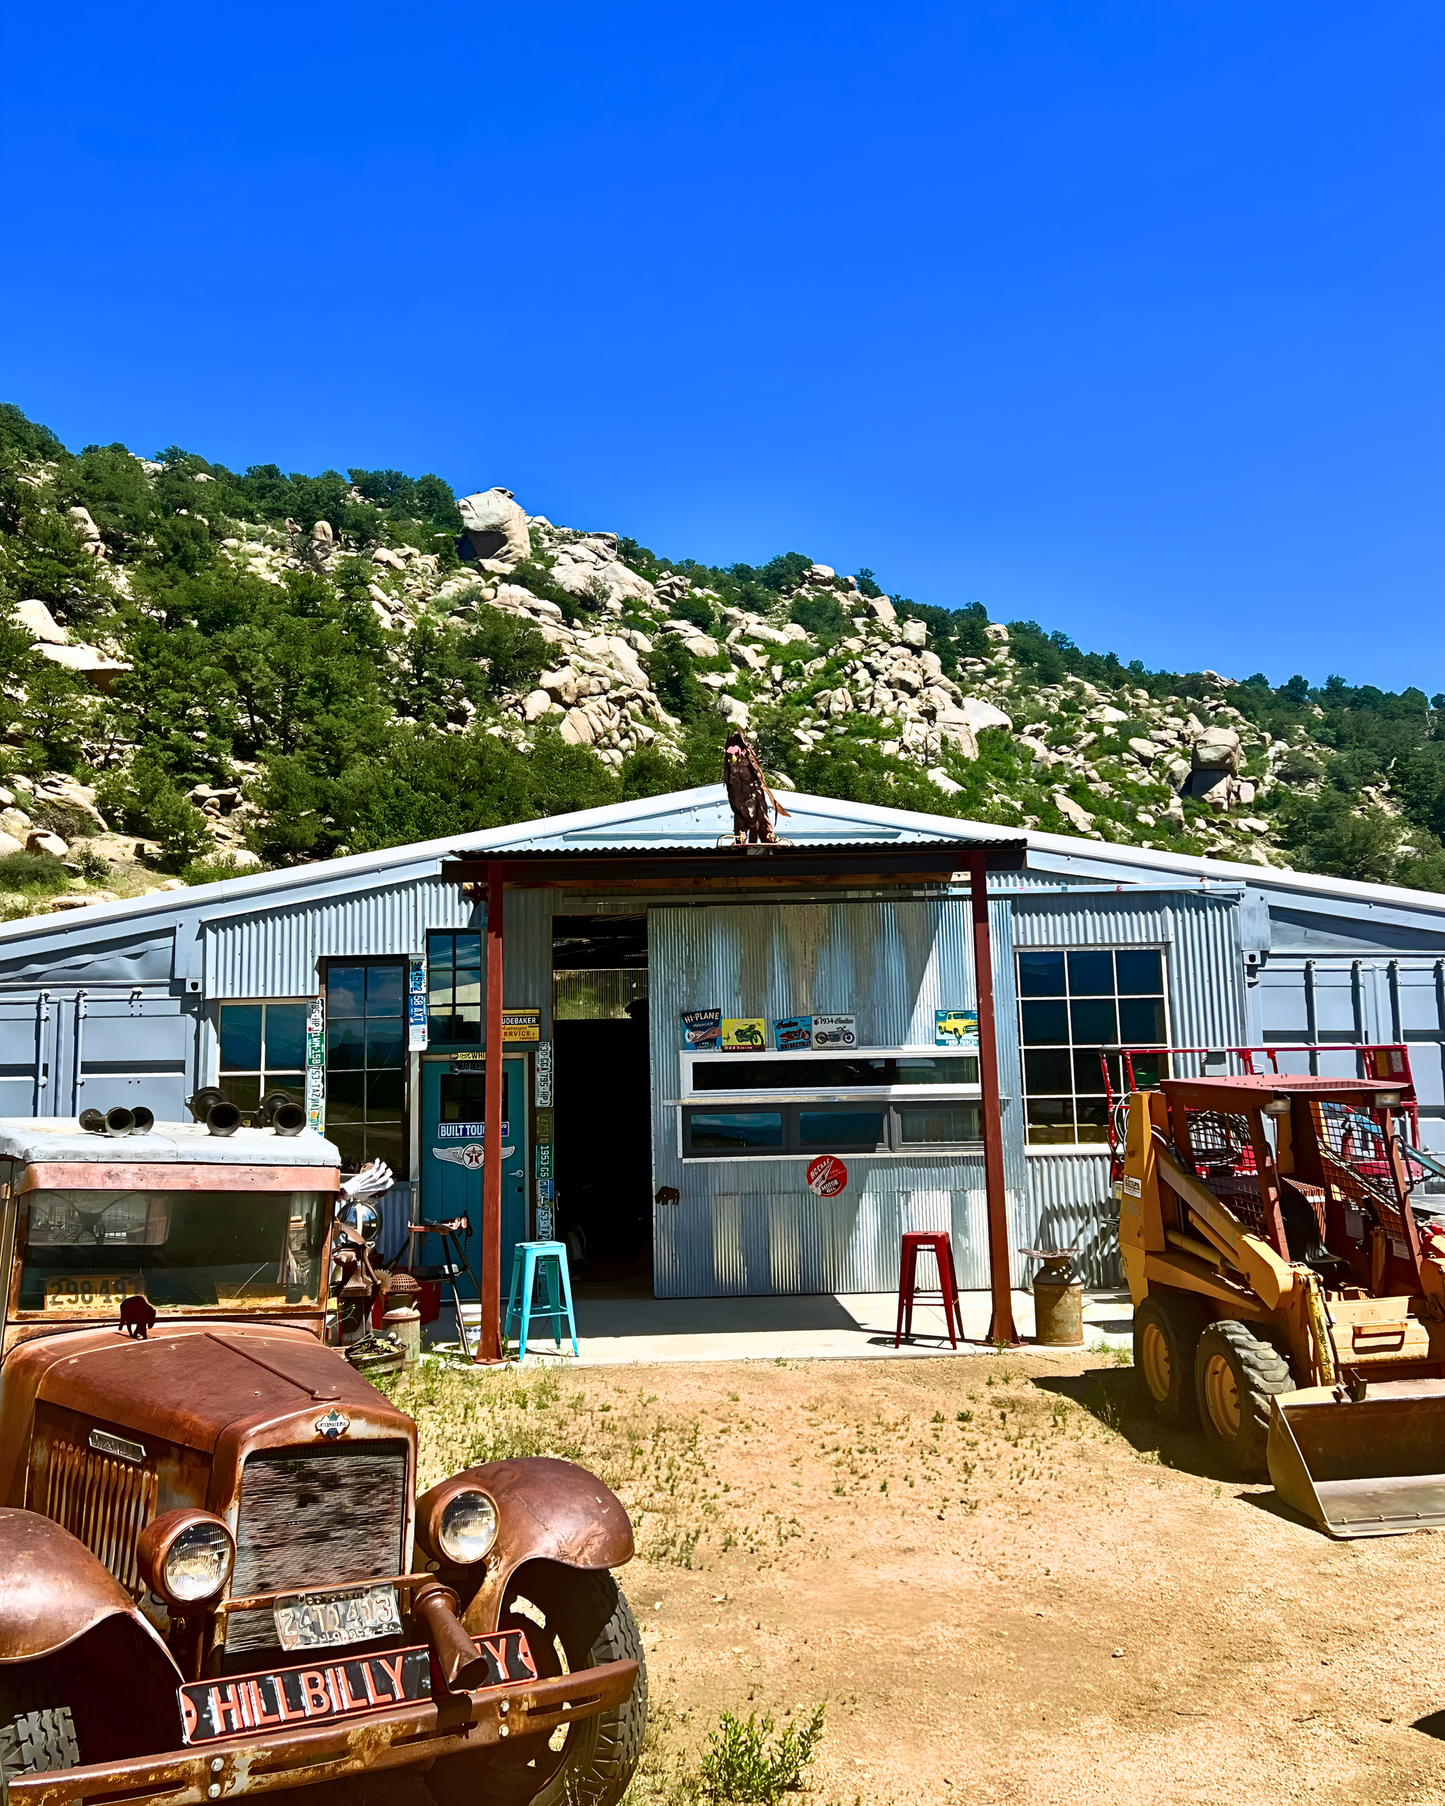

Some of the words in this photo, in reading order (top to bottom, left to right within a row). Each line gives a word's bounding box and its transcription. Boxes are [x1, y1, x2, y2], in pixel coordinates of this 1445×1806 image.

[413, 995, 424, 1006] 58
[413, 1007, 424, 1022] AXT
[683, 1011, 720, 1024] HI-PLANE
[502, 1017, 537, 1025] UDEBAKER
[440, 1125, 464, 1137] BUILT
[465, 1125, 486, 1136] TOU
[208, 1655, 406, 1734] HILLBILLY
